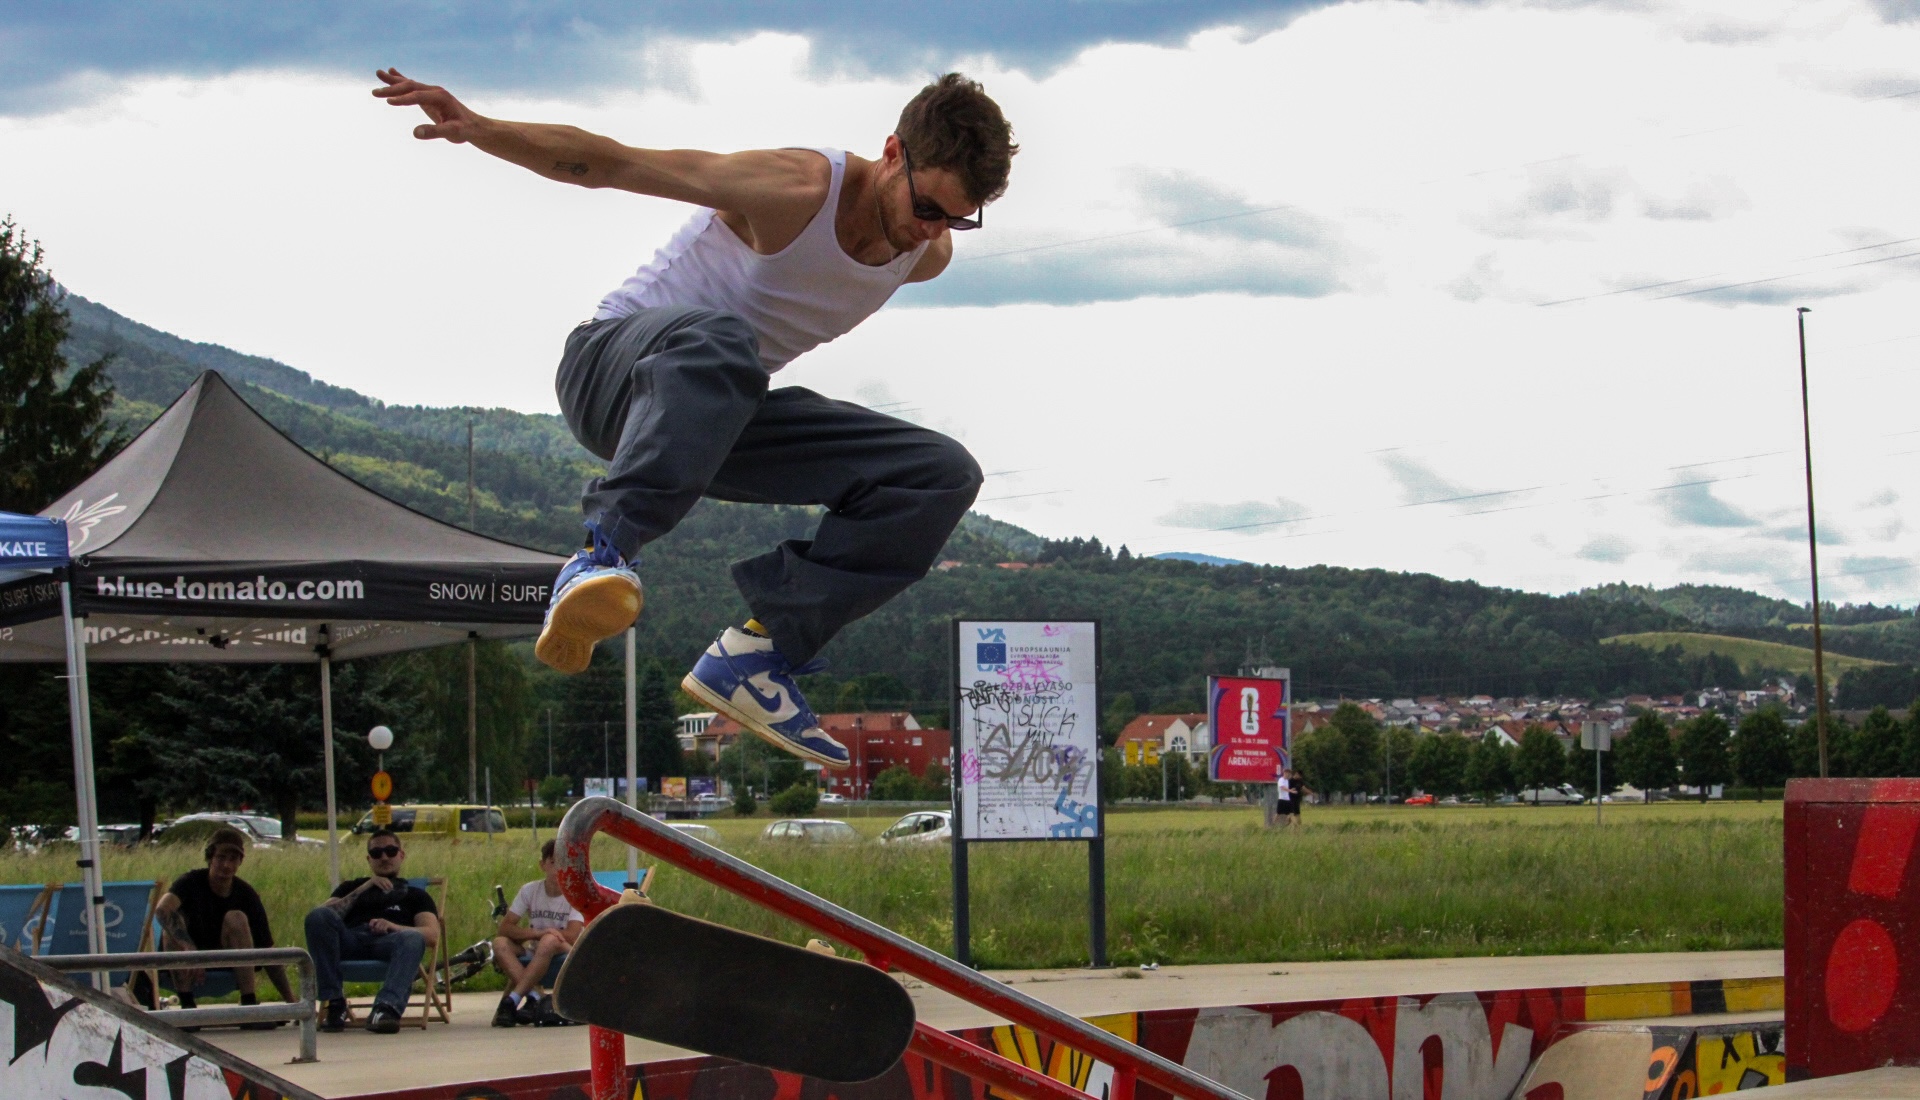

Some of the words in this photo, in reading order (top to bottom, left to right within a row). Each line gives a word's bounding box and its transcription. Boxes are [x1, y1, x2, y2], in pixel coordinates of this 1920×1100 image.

[97, 576, 364, 600] blue-tomato.com
[429, 582, 486, 600] SNOW
[500, 584, 549, 602] SURF
